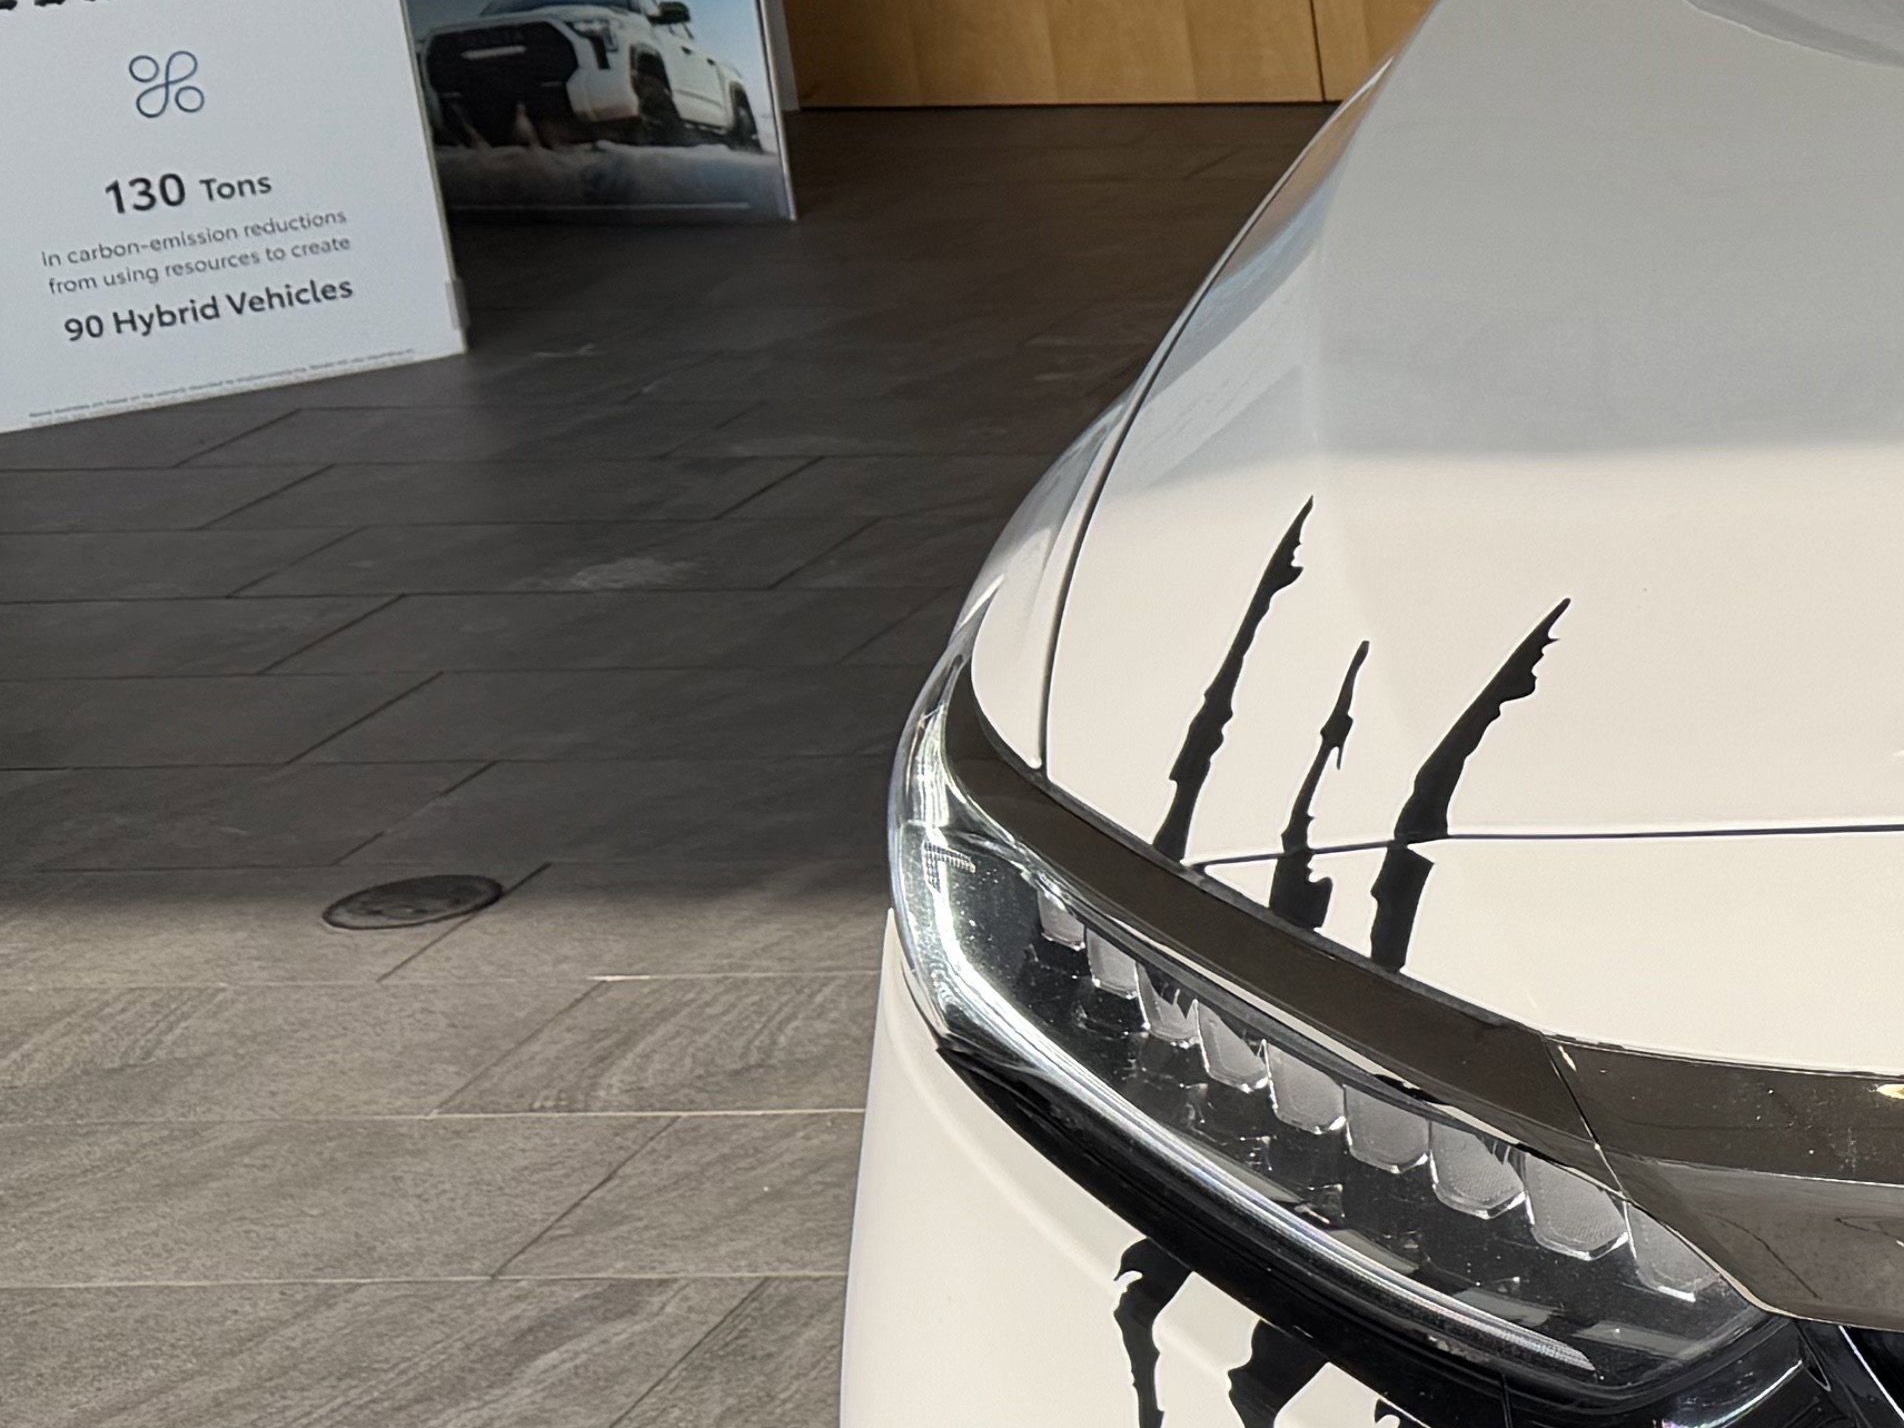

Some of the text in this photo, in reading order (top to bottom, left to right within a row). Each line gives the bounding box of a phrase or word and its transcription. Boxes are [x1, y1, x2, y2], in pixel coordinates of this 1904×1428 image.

[104, 172, 273, 214] 130 Tons
[41, 210, 347, 267] in carbon-emission reductions
[49, 237, 351, 295] from using resources to create
[64, 279, 354, 341] 90 Hybrid Vehicles
